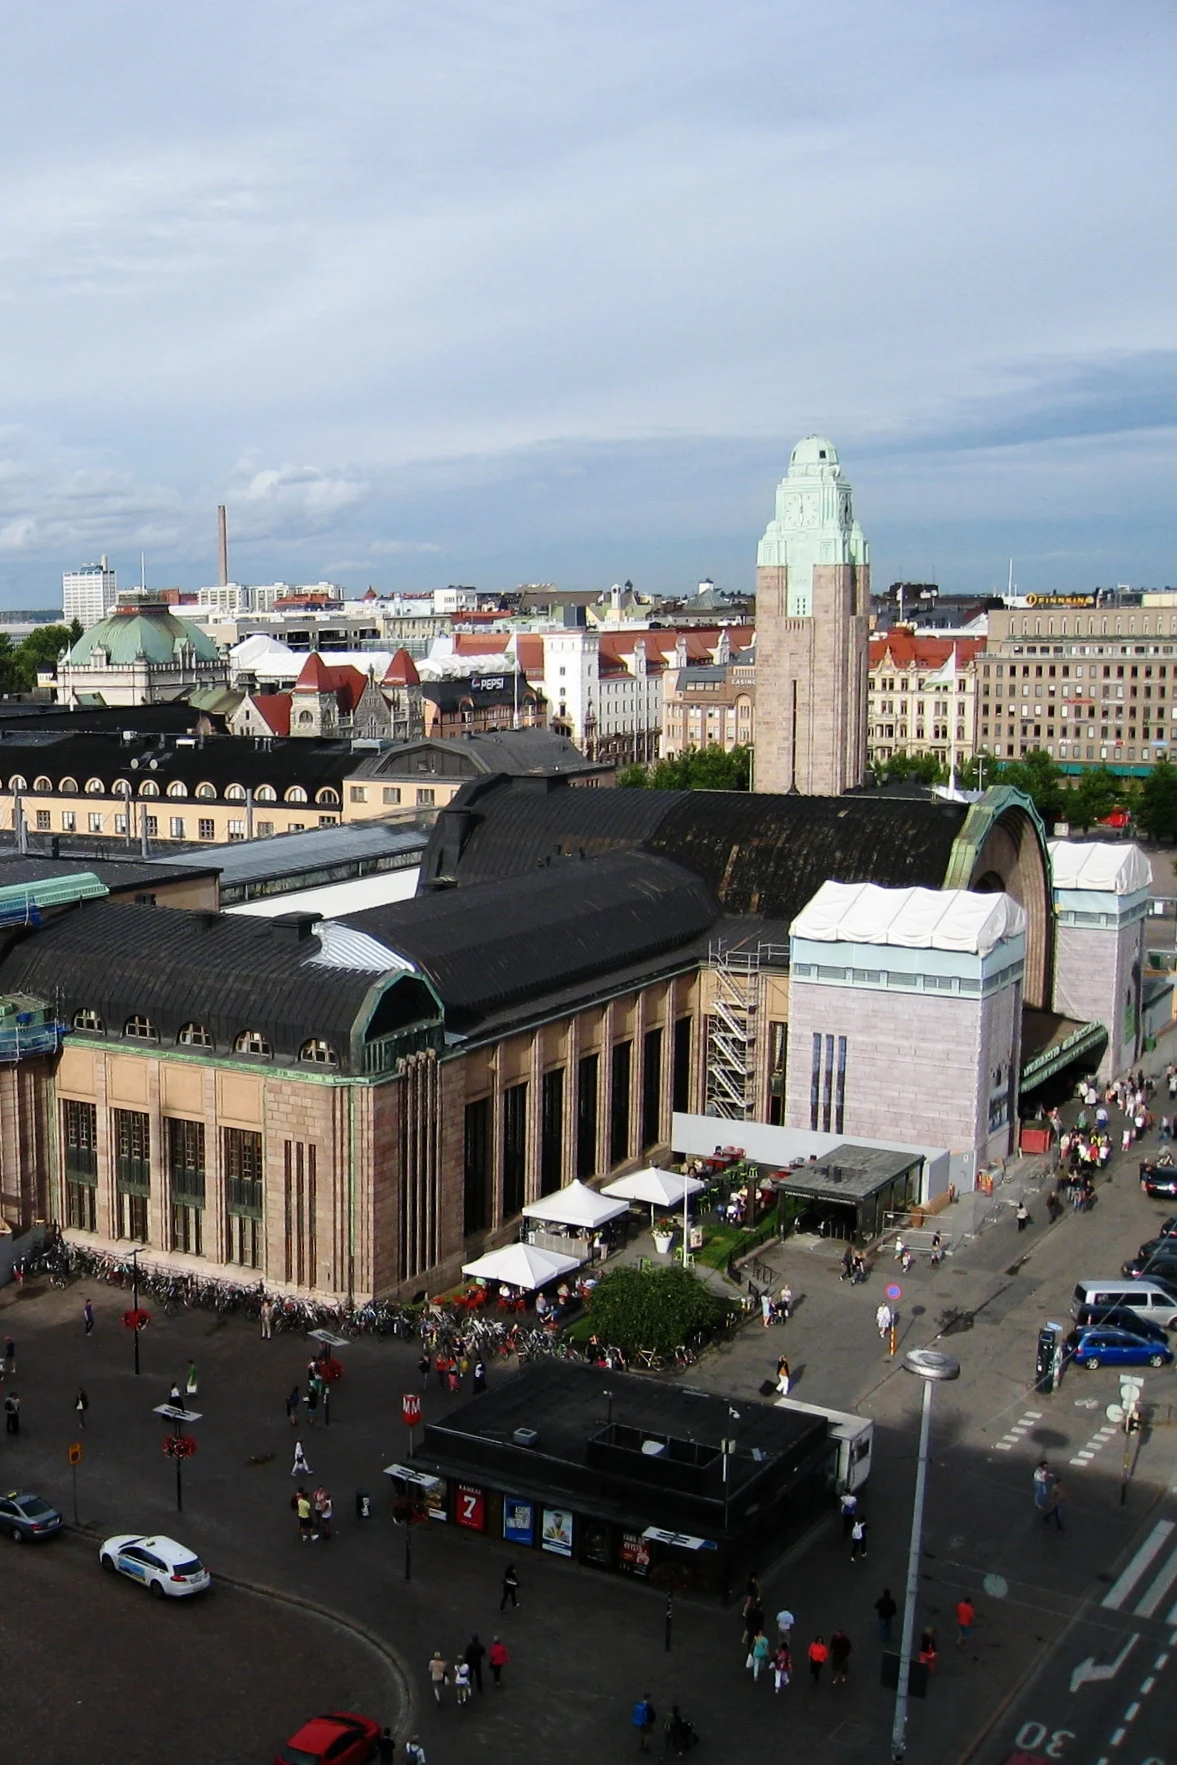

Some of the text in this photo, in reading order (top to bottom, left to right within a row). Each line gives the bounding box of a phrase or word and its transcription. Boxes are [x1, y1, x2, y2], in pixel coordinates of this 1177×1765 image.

[480, 678, 504, 690] PEPSI
[463, 1495, 476, 1519] 7
[1015, 1721, 1076, 1758] 30
